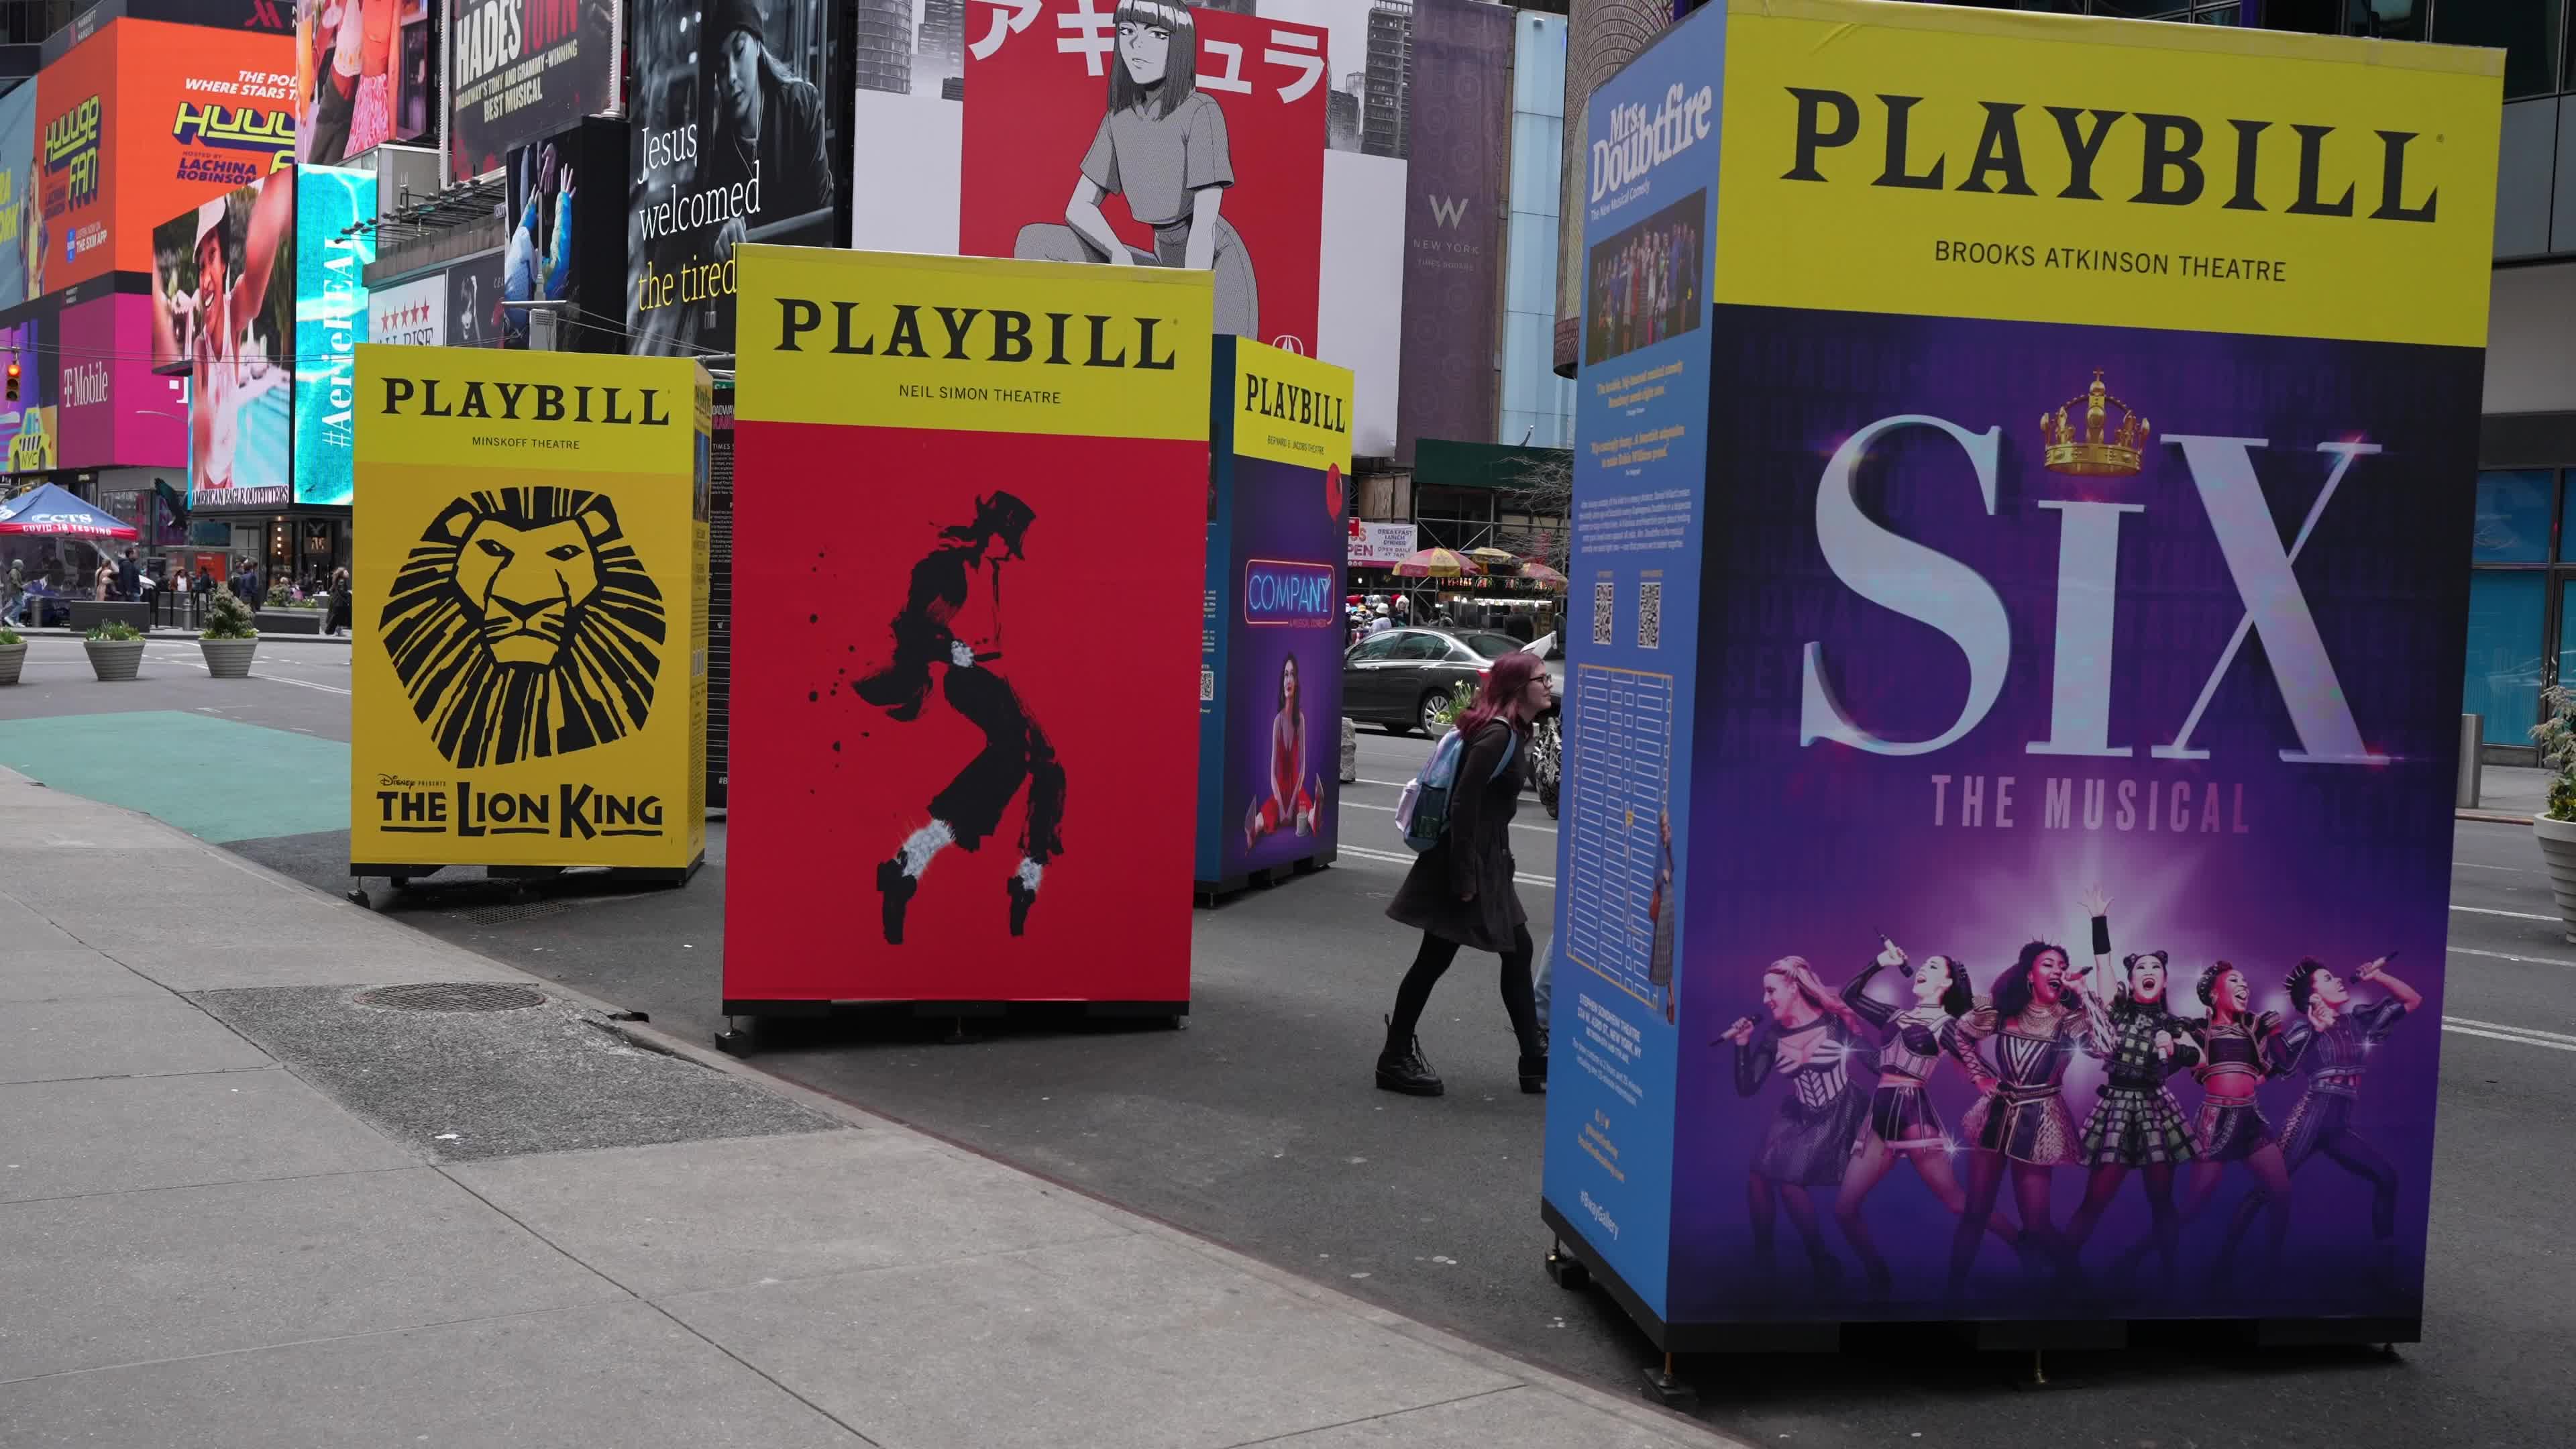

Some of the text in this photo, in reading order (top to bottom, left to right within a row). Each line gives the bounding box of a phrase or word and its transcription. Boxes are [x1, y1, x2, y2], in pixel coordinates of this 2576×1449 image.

[185, 78, 239, 94] WHERE
[241, 85, 286, 100] STARS
[238, 70, 297, 88] THE POD
[488, 73, 504, 95] TONY
[504, 67, 516, 88] AND
[484, 76, 543, 123] BEST MUSICAL
[638, 123, 697, 184] Jesus
[1591, 81, 1712, 204] Doubtfire
[1779, 86, 2437, 223] PLAYBILL
[176, 170, 258, 185] ROBINSON
[179, 158, 258, 175] LACHINA
[639, 160, 761, 241] welcomed
[1428, 194, 1469, 231] W
[1413, 238, 1480, 254] NEW YORK
[1934, 239, 2288, 282] BROOKS ATKINSON THEATRE
[639, 242, 737, 311] the tired
[773, 297, 1175, 370] PLAYBILL
[380, 377, 669, 426] PLAYBILL
[898, 384, 1061, 405] NEIL SIMON THEATRE
[1244, 373, 1346, 433] PLAYBILL
[21, 451, 38, 468] NYC
[472, 435, 580, 450] MINSKOFF THEATRE
[193, 485, 288, 505] AMERICAN EAGLE OUTFITTERS
[72, 525, 111, 536] TESTING
[1377, 528, 1412, 536] BREAKFAST
[1347, 544, 1373, 556] PEN
[1248, 574, 1332, 612] COMPANY
[1800, 414, 2390, 764] SIX
[376, 782, 663, 841] THE LION KING
[1931, 774, 2250, 835] THE MUSICAL
